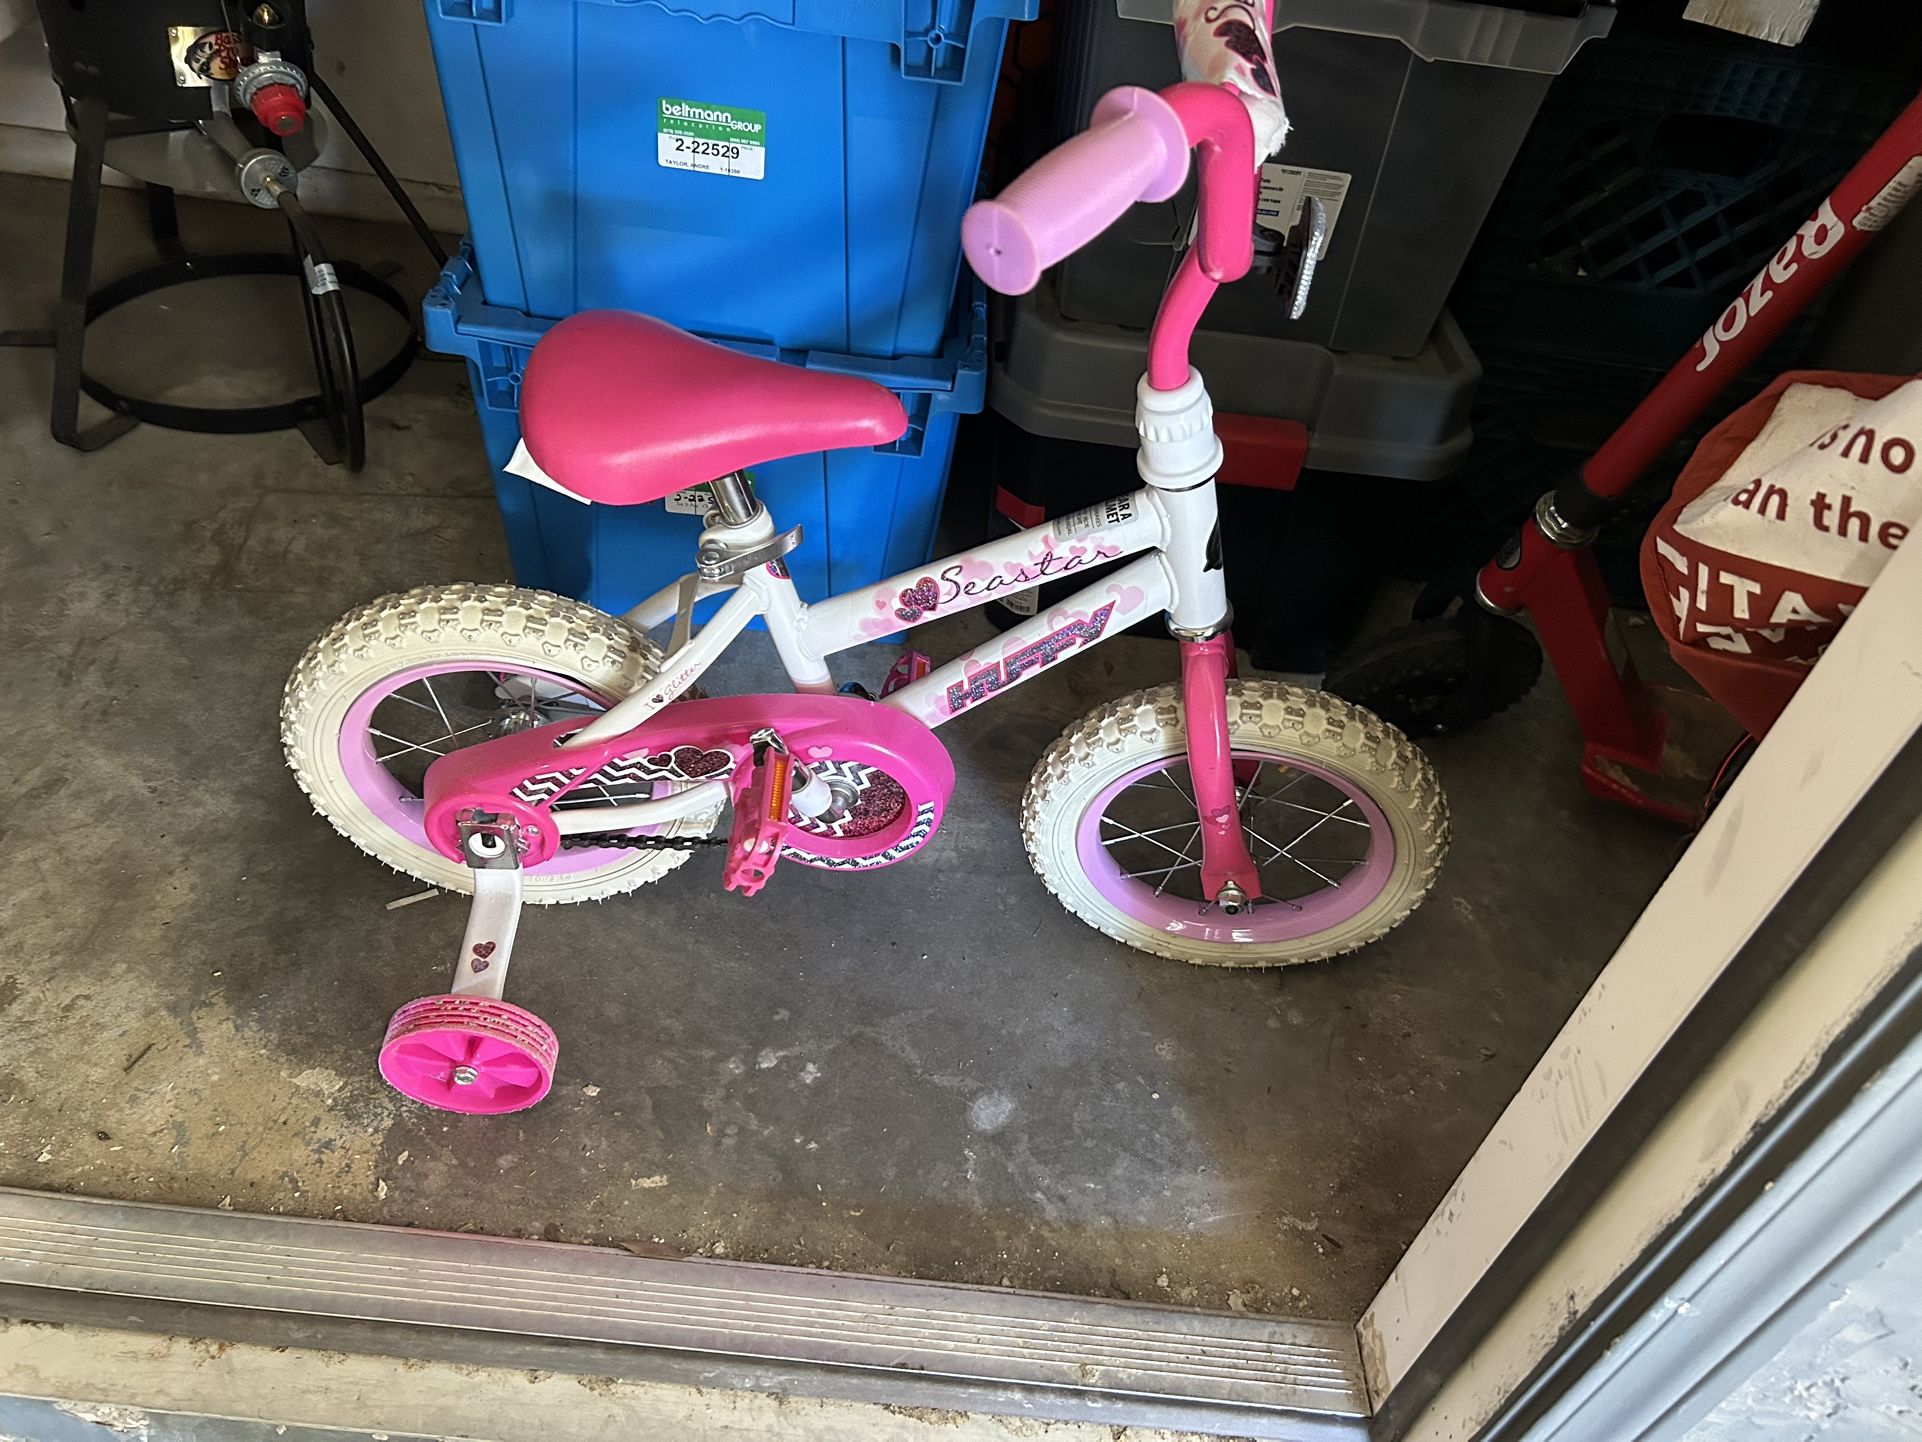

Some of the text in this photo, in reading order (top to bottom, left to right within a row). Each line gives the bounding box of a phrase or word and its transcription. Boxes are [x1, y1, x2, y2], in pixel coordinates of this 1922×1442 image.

[662, 99, 762, 133] beltmann GROUP
[663, 118, 731, 132] relocation
[675, 138, 740, 160] 2-22529
[1696, 196, 1845, 372] Razor
[1727, 478, 1910, 550] an the
[939, 551, 1123, 604] Seastar
[947, 600, 1116, 714] HUFFY
